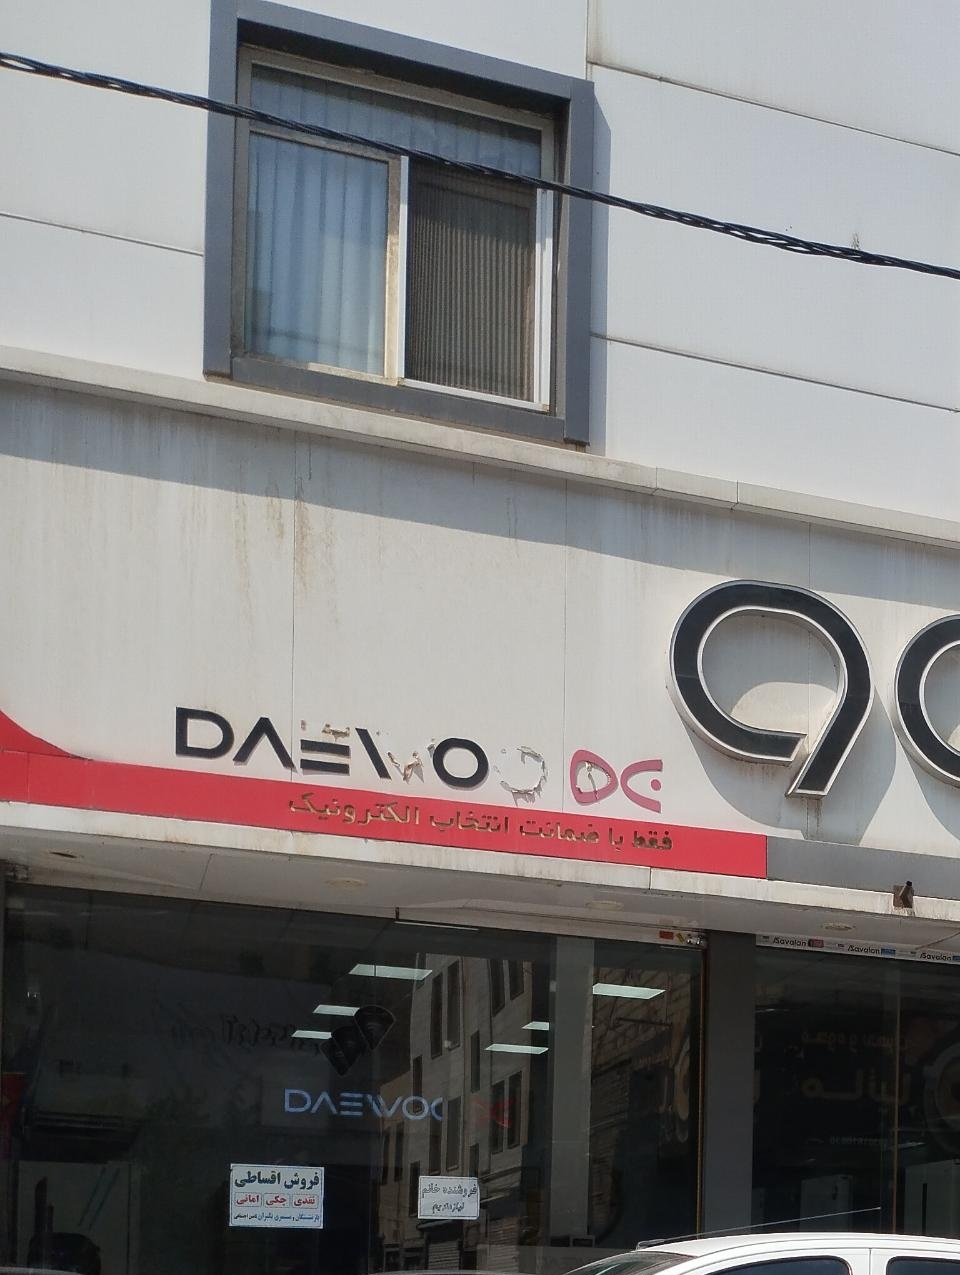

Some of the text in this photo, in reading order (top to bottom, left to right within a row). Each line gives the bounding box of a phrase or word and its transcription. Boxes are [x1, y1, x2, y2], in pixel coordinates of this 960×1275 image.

[289, 794, 674, 852] فقط با ضمانت انتخاب الکترونیک
[234, 1170, 320, 1190] فروش اقساطی
